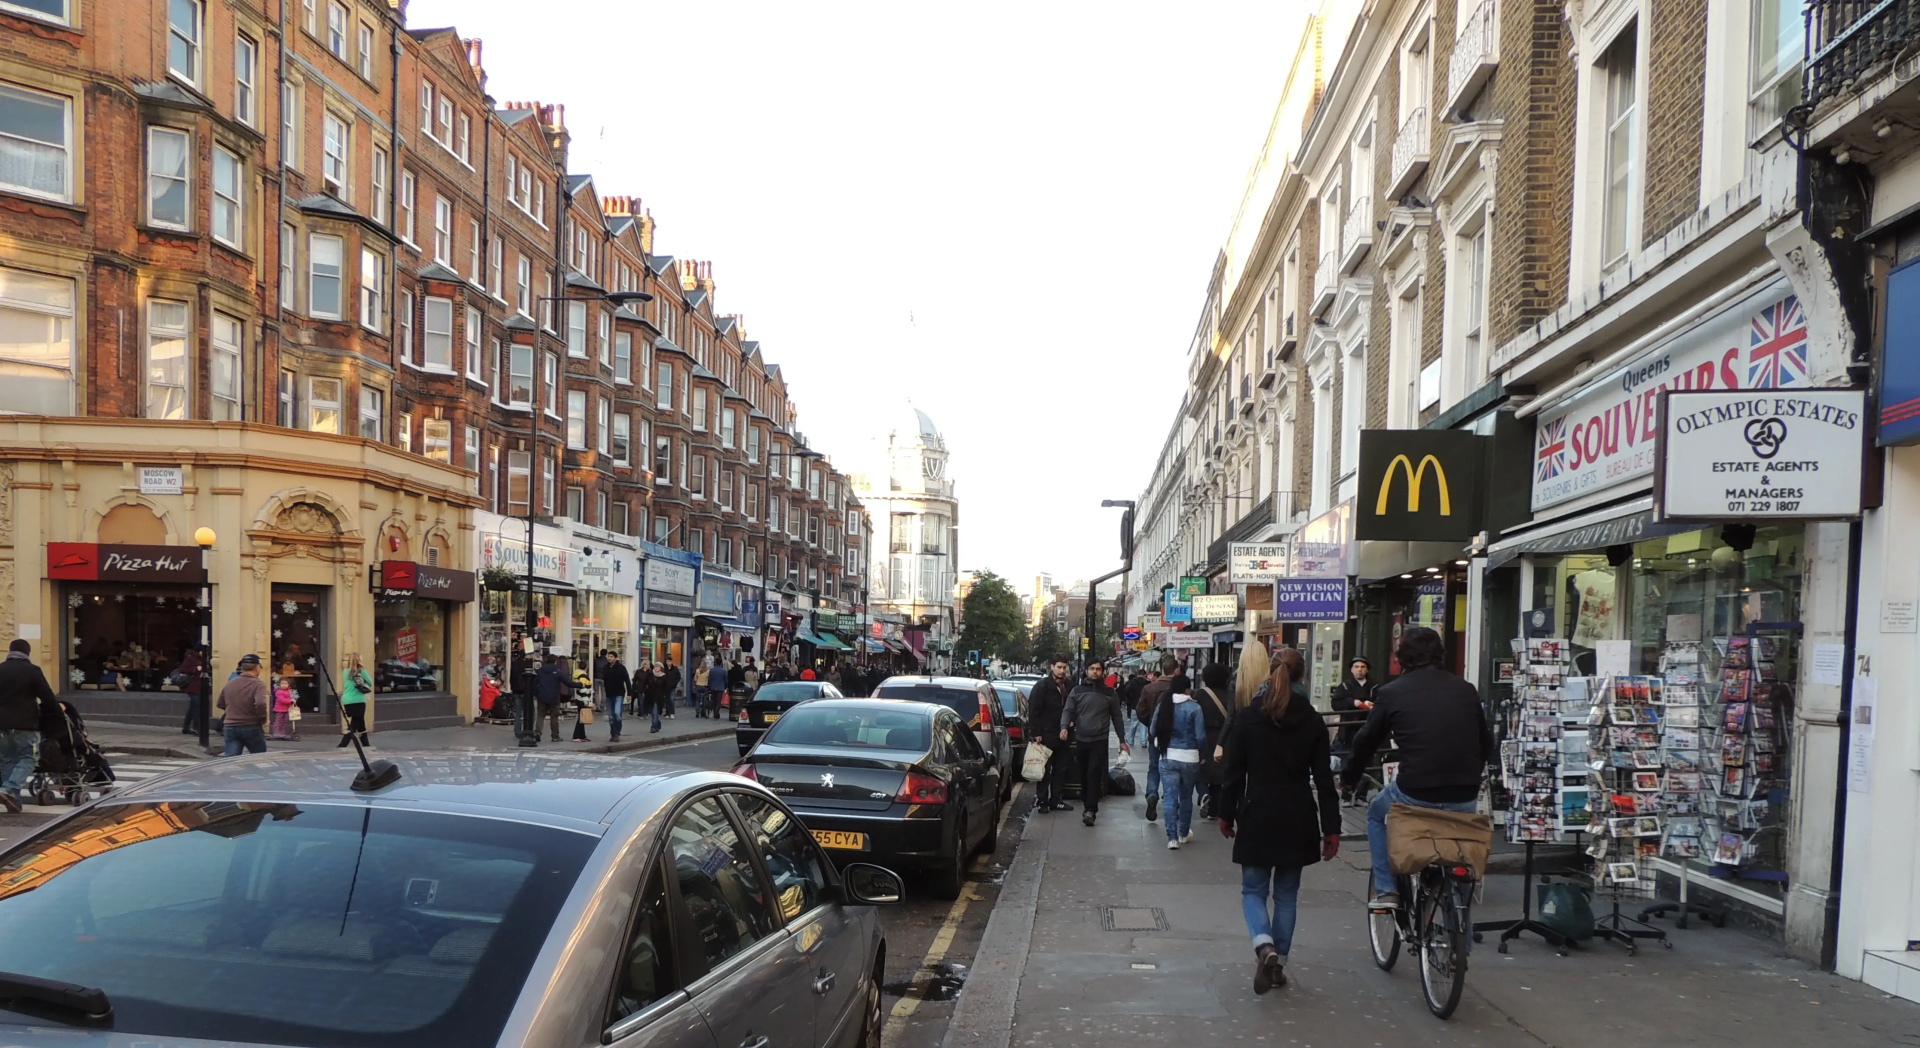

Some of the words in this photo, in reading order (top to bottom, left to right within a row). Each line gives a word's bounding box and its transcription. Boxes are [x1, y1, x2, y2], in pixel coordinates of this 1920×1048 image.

[1622, 355, 1670, 393] Queens
[1676, 399, 1768, 434] OLYMPIC
[1773, 399, 1859, 430] ESTATES
[144, 469, 175, 477] MOSCOW
[1712, 462, 1760, 473] ESTATE
[1764, 461, 1820, 472] AGENTS
[166, 478, 176, 486] W2
[1760, 475, 1771, 486] &
[1725, 488, 1804, 499] MANAGERS
[1728, 502, 1745, 512] 071
[1750, 502, 1771, 512] 229
[1775, 501, 1800, 512] 1807
[1564, 516, 1646, 548] SOUVENIRS
[494, 540, 558, 571] SOUVNIRS
[1233, 547, 1257, 556] ESTATE
[1258, 547, 1286, 557] AGENTS
[104, 553, 153, 571] Pizza
[153, 555, 191, 571] Hut
[665, 567, 679, 579] SONY
[417, 573, 438, 588] Pizza
[438, 576, 453, 589] Hut
[1279, 583, 1303, 592] NEW
[1306, 583, 1343, 592] VISION
[1280, 592, 1342, 602] OPTICIAN
[1857, 655, 1871, 677] 74
[810, 831, 832, 844] 55
[835, 833, 859, 846] CYA
